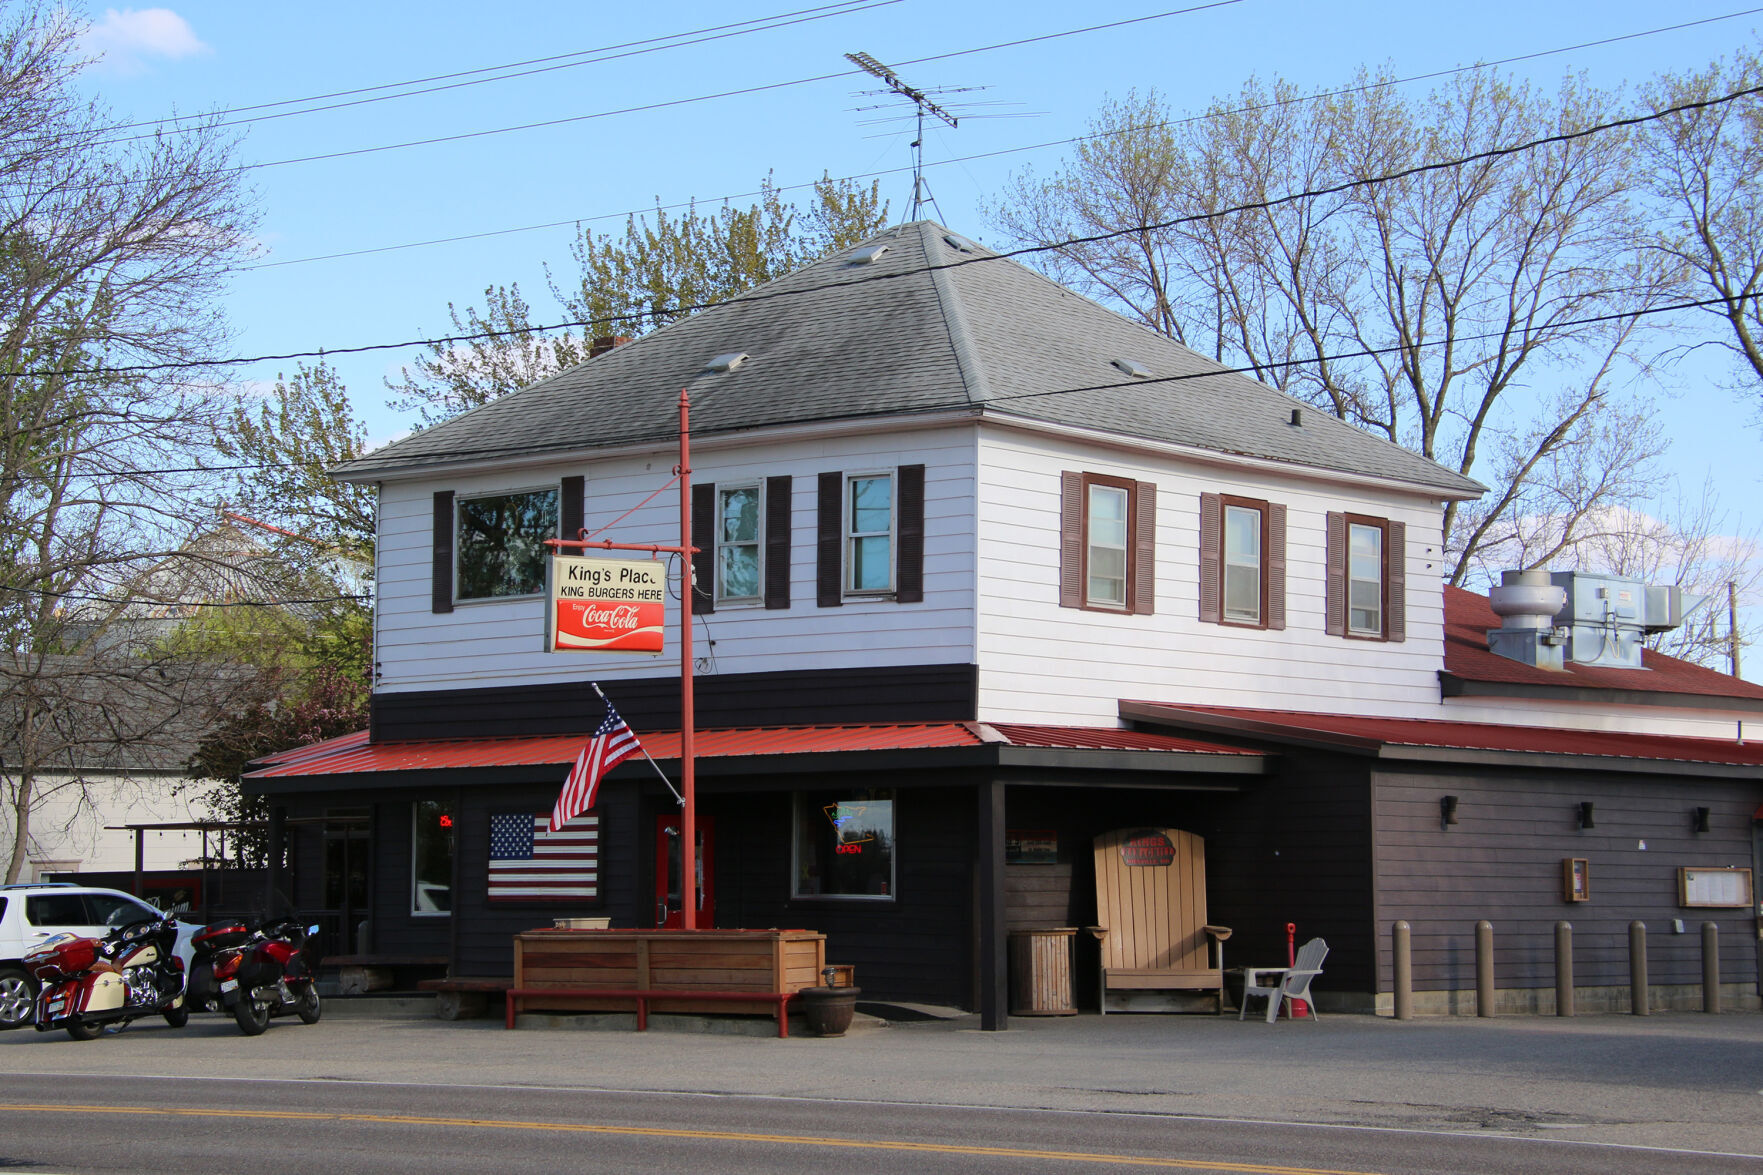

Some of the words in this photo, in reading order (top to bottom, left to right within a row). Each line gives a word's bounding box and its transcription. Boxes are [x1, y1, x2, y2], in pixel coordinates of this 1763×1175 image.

[568, 565, 612, 585] King's
[560, 586, 584, 597] KING
[588, 588, 635, 599] BURGERS
[638, 589, 662, 600] HERE
[572, 603, 586, 612] Enjoy
[582, 604, 640, 629] Coca-Cola
[835, 845, 862, 855] OPEN
